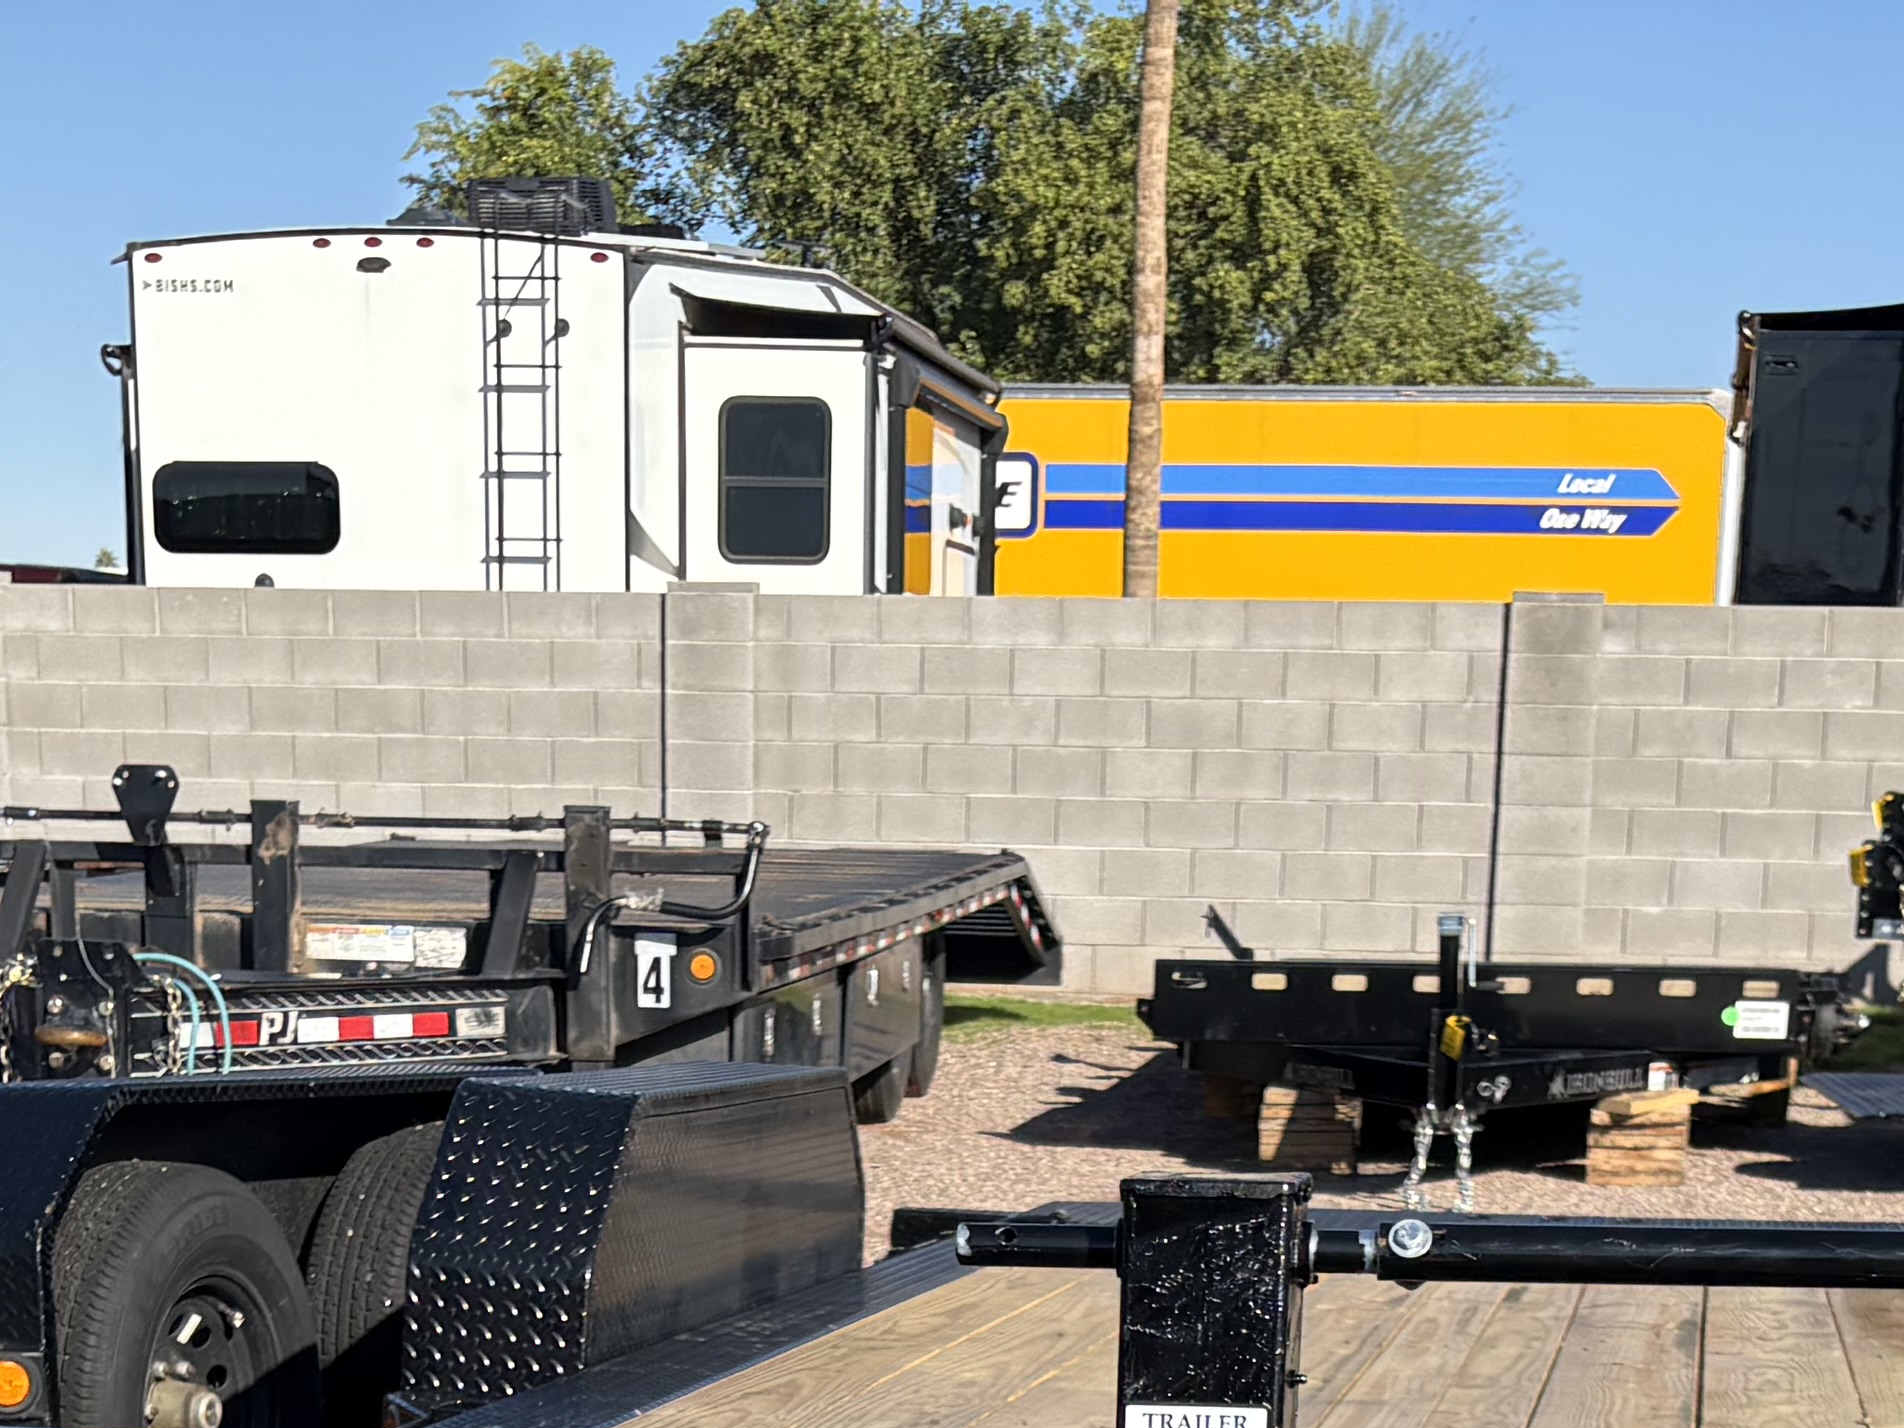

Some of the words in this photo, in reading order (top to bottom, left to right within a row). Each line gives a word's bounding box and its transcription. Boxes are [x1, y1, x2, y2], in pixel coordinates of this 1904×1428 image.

[1557, 473, 1616, 494] Local
[1539, 508, 1580, 529] One
[1581, 508, 1628, 534] Way
[643, 957, 665, 1004] 4
[259, 1010, 298, 1045] PJ
